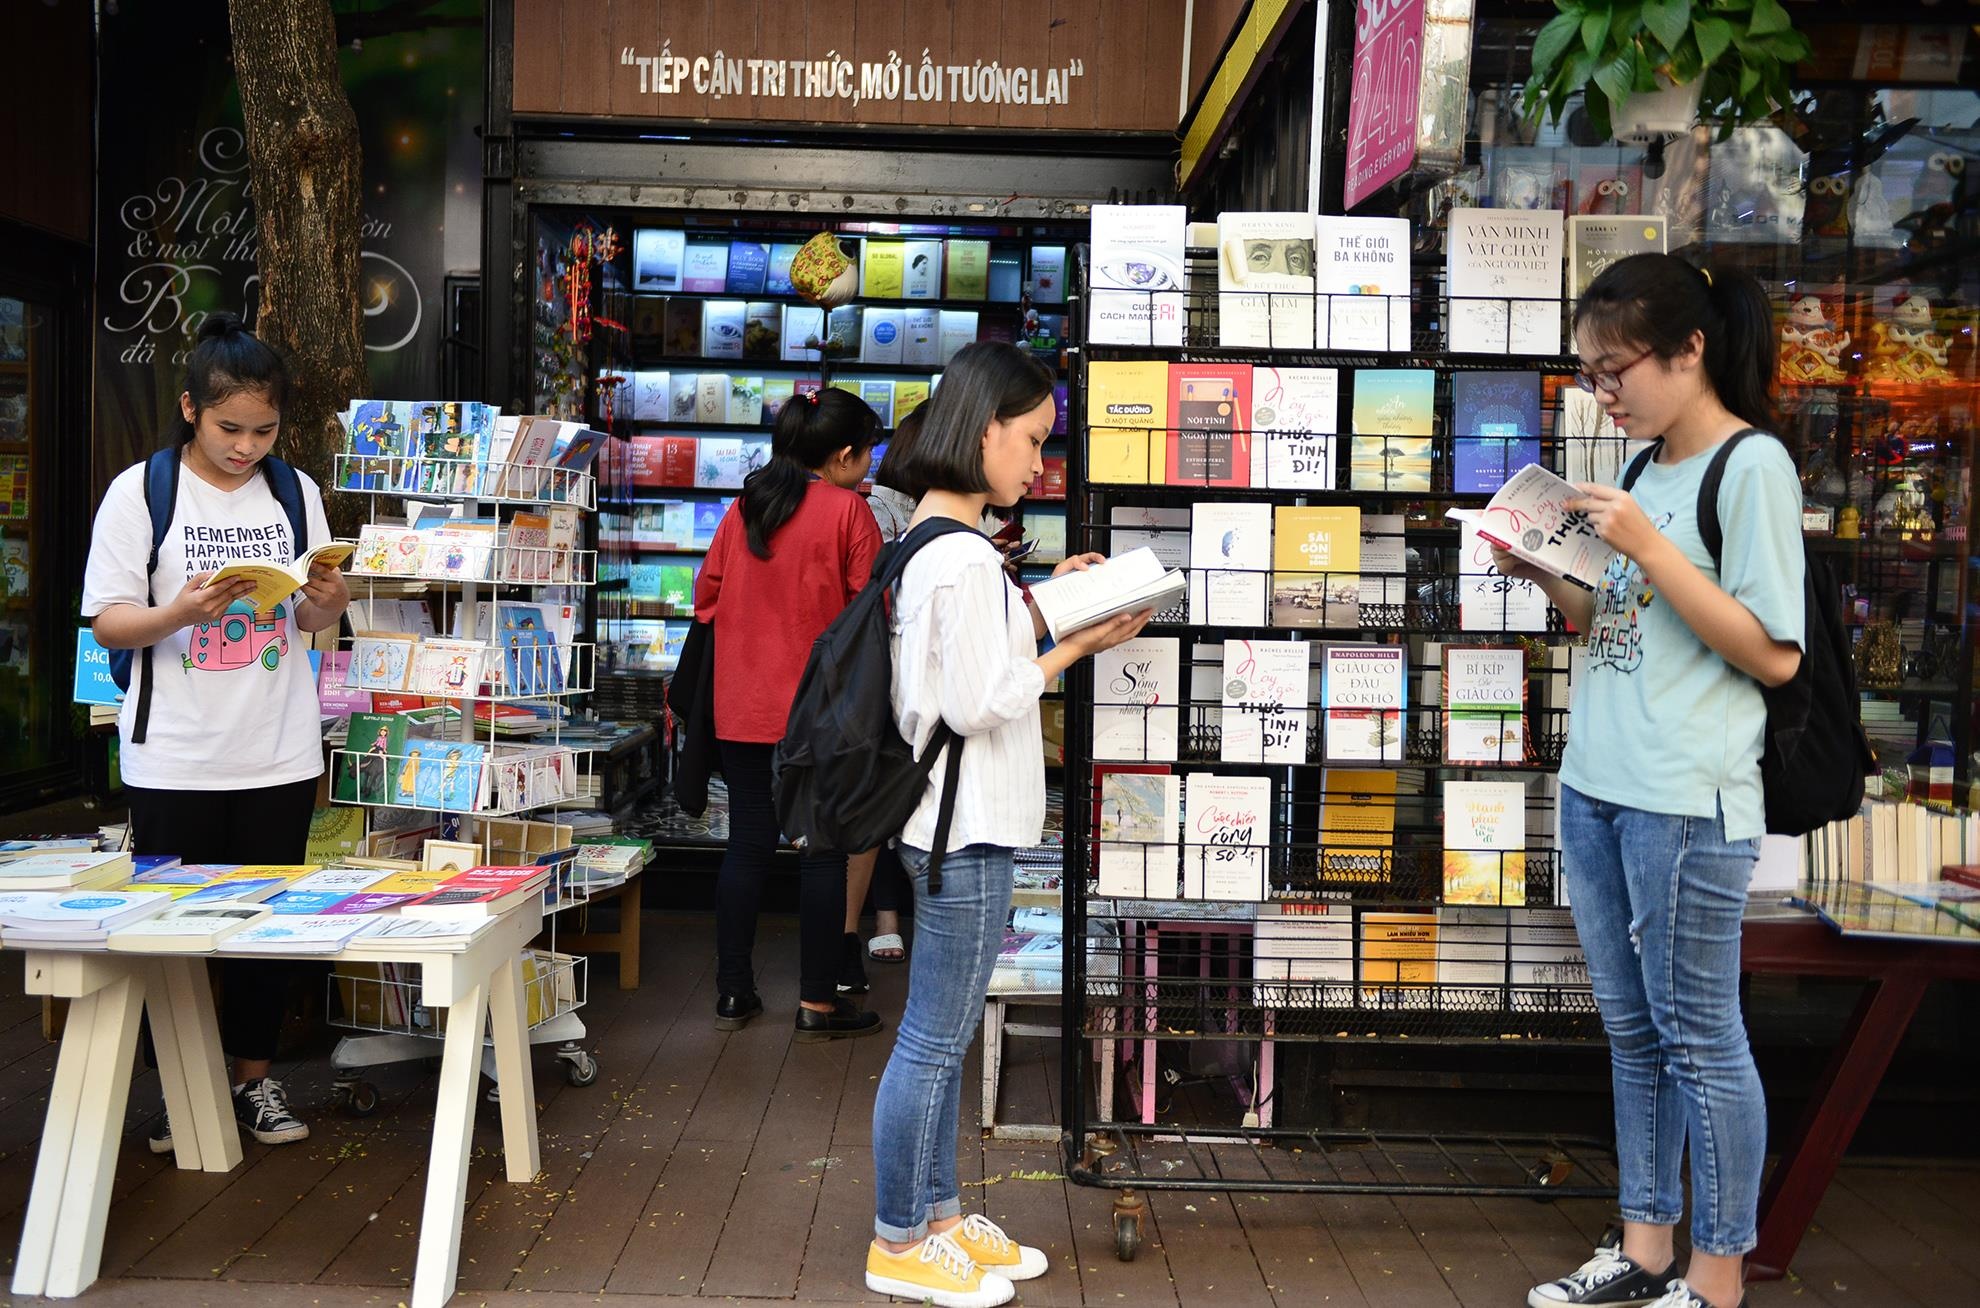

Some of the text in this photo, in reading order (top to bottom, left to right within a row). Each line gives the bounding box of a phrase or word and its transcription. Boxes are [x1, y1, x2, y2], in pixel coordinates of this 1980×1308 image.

[693, 50, 743, 99] CẬN
[747, 60, 786, 96] TRI
[904, 48, 943, 102] LỐI
[947, 59, 1028, 104] TƯƠNG
[1349, 20, 1417, 169] 24h
[127, 231, 153, 258] &
[1366, 236, 1389, 250] GIỚI
[1334, 251, 1349, 262] BA
[184, 523, 287, 543] REMEMBER
[185, 540, 290, 559] HAPPINESS IS
[186, 560, 226, 571] A WAY
[84, 650, 109, 665] SÁC
[1493, 687, 1515, 700] CÓ
